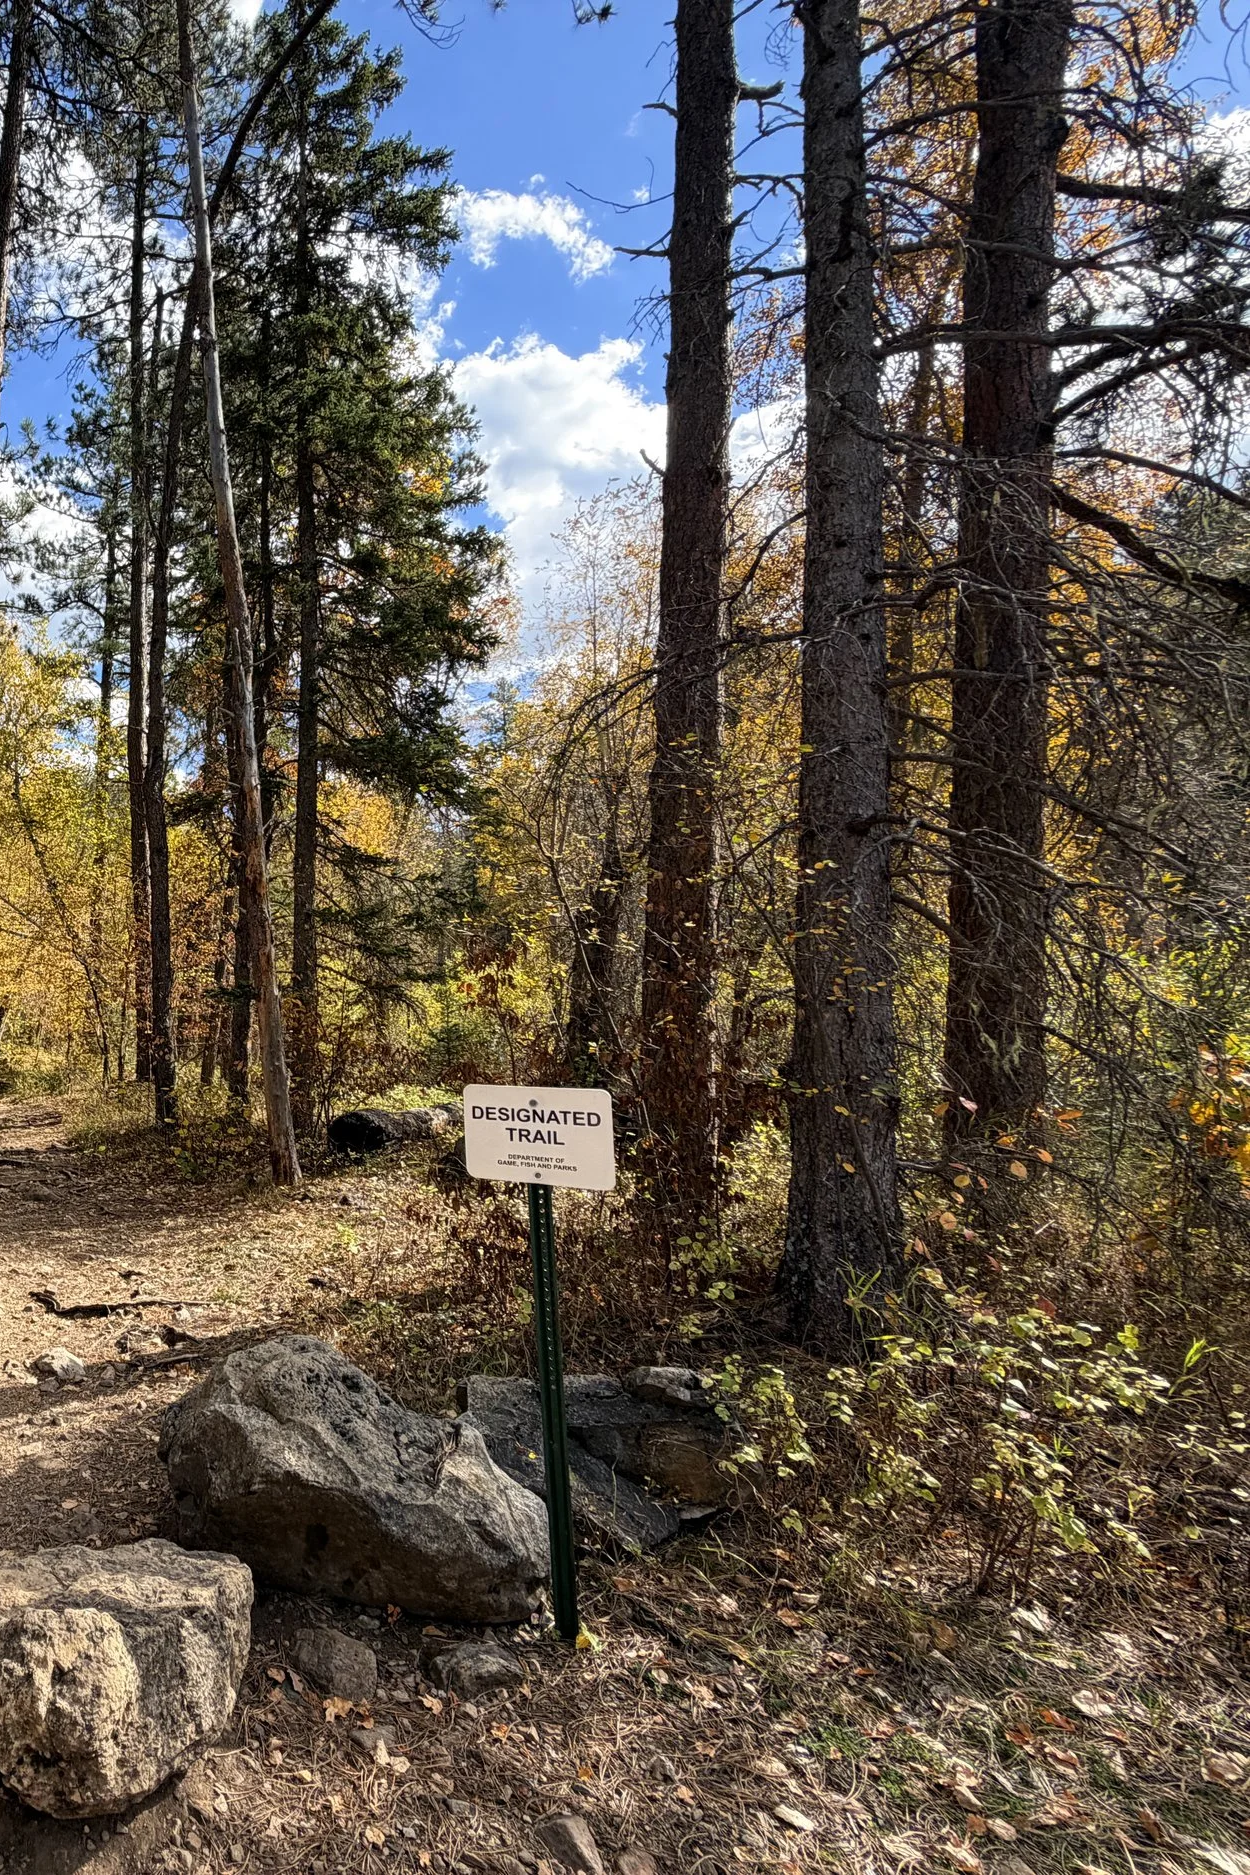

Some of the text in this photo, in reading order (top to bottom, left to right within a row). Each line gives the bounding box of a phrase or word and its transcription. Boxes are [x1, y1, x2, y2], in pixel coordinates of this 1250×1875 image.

[472, 1106, 601, 1127] DESIGNATED
[505, 1127, 565, 1145] TRAIL
[498, 1159, 519, 1167] GAME,
[508, 1153, 553, 1163] DEPARTMENT
